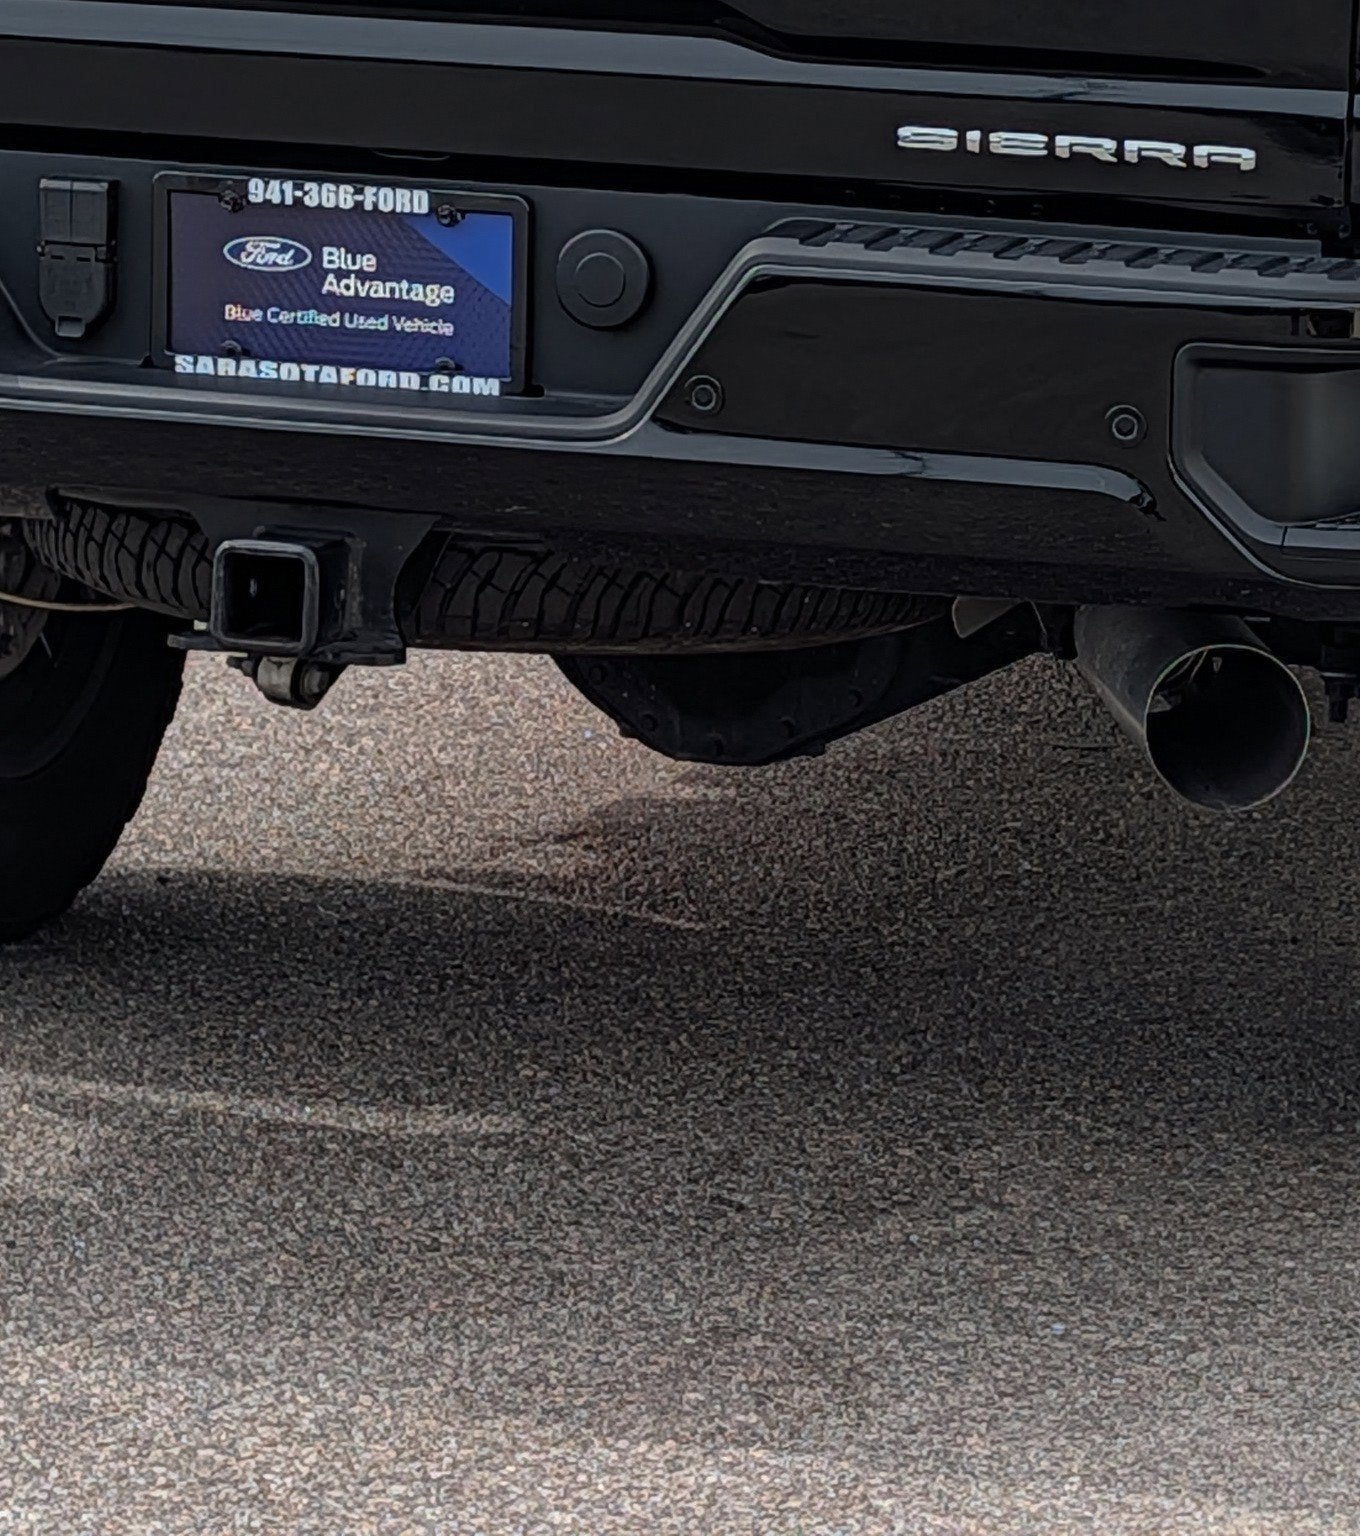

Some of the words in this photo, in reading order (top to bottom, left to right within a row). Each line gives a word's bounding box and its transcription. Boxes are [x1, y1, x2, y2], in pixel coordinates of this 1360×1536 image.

[896, 126, 1256, 170] SIERRA
[247, 178, 430, 214] 941-366-FORD
[240, 239, 296, 267] Ford
[322, 246, 377, 272] Blue
[321, 273, 455, 307] Advantage
[224, 304, 263, 322] Blue
[267, 306, 340, 328] Certified
[344, 312, 389, 331] Used
[392, 315, 455, 337] Vehicle
[174, 354, 501, 397] SARASOTAFORD.COM
